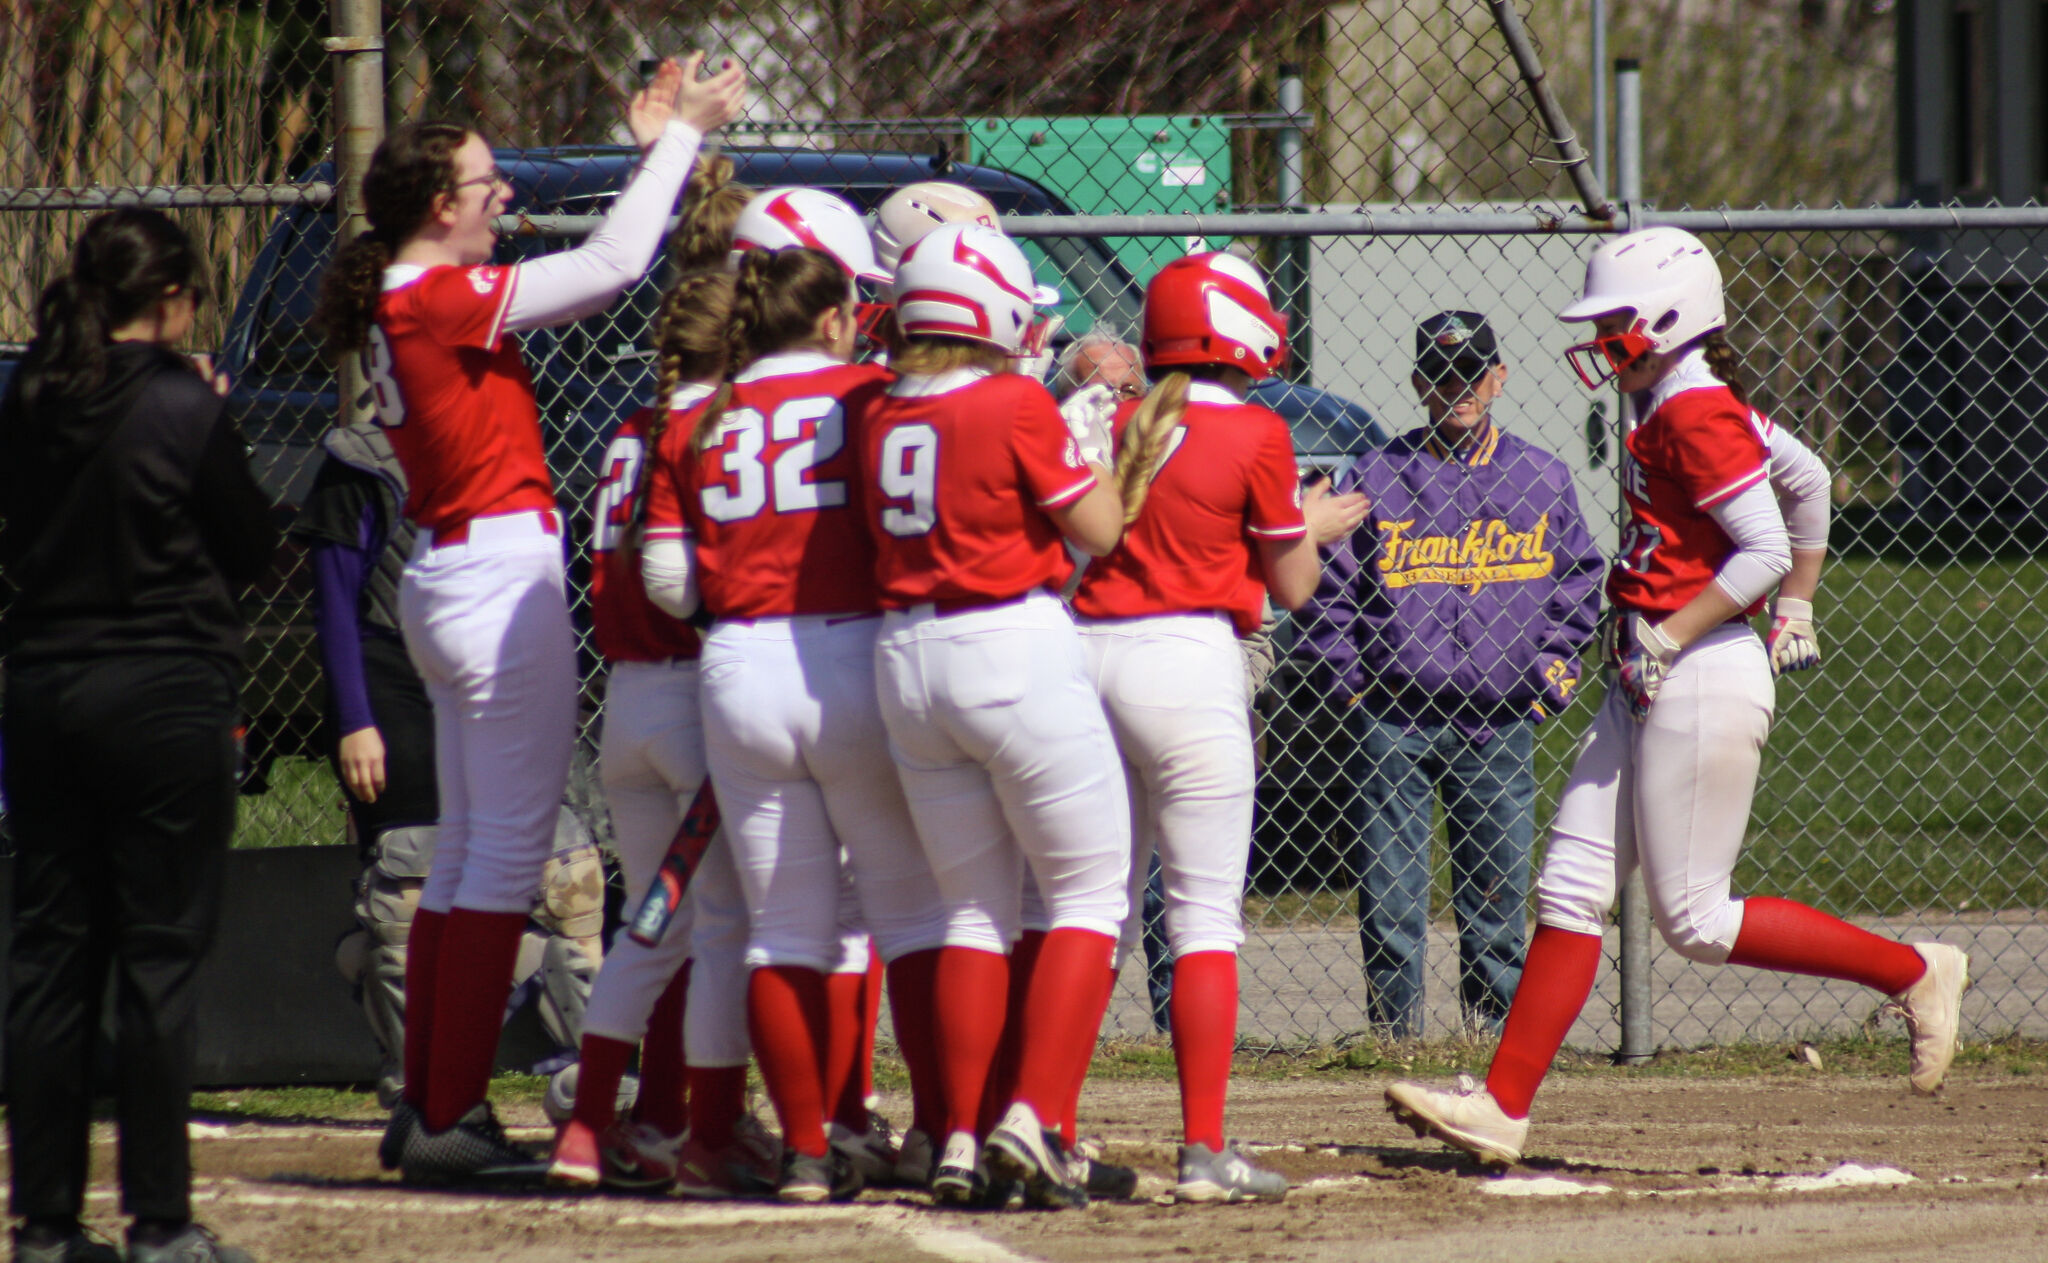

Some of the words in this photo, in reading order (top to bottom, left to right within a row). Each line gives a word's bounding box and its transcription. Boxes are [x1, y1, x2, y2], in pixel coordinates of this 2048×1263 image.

[701, 394, 847, 524] 32
[878, 422, 938, 538] 9
[1378, 512, 1553, 590] Frankfort
[1404, 566, 1522, 584] BASEBALL
[1544, 658, 1578, 698] 24
